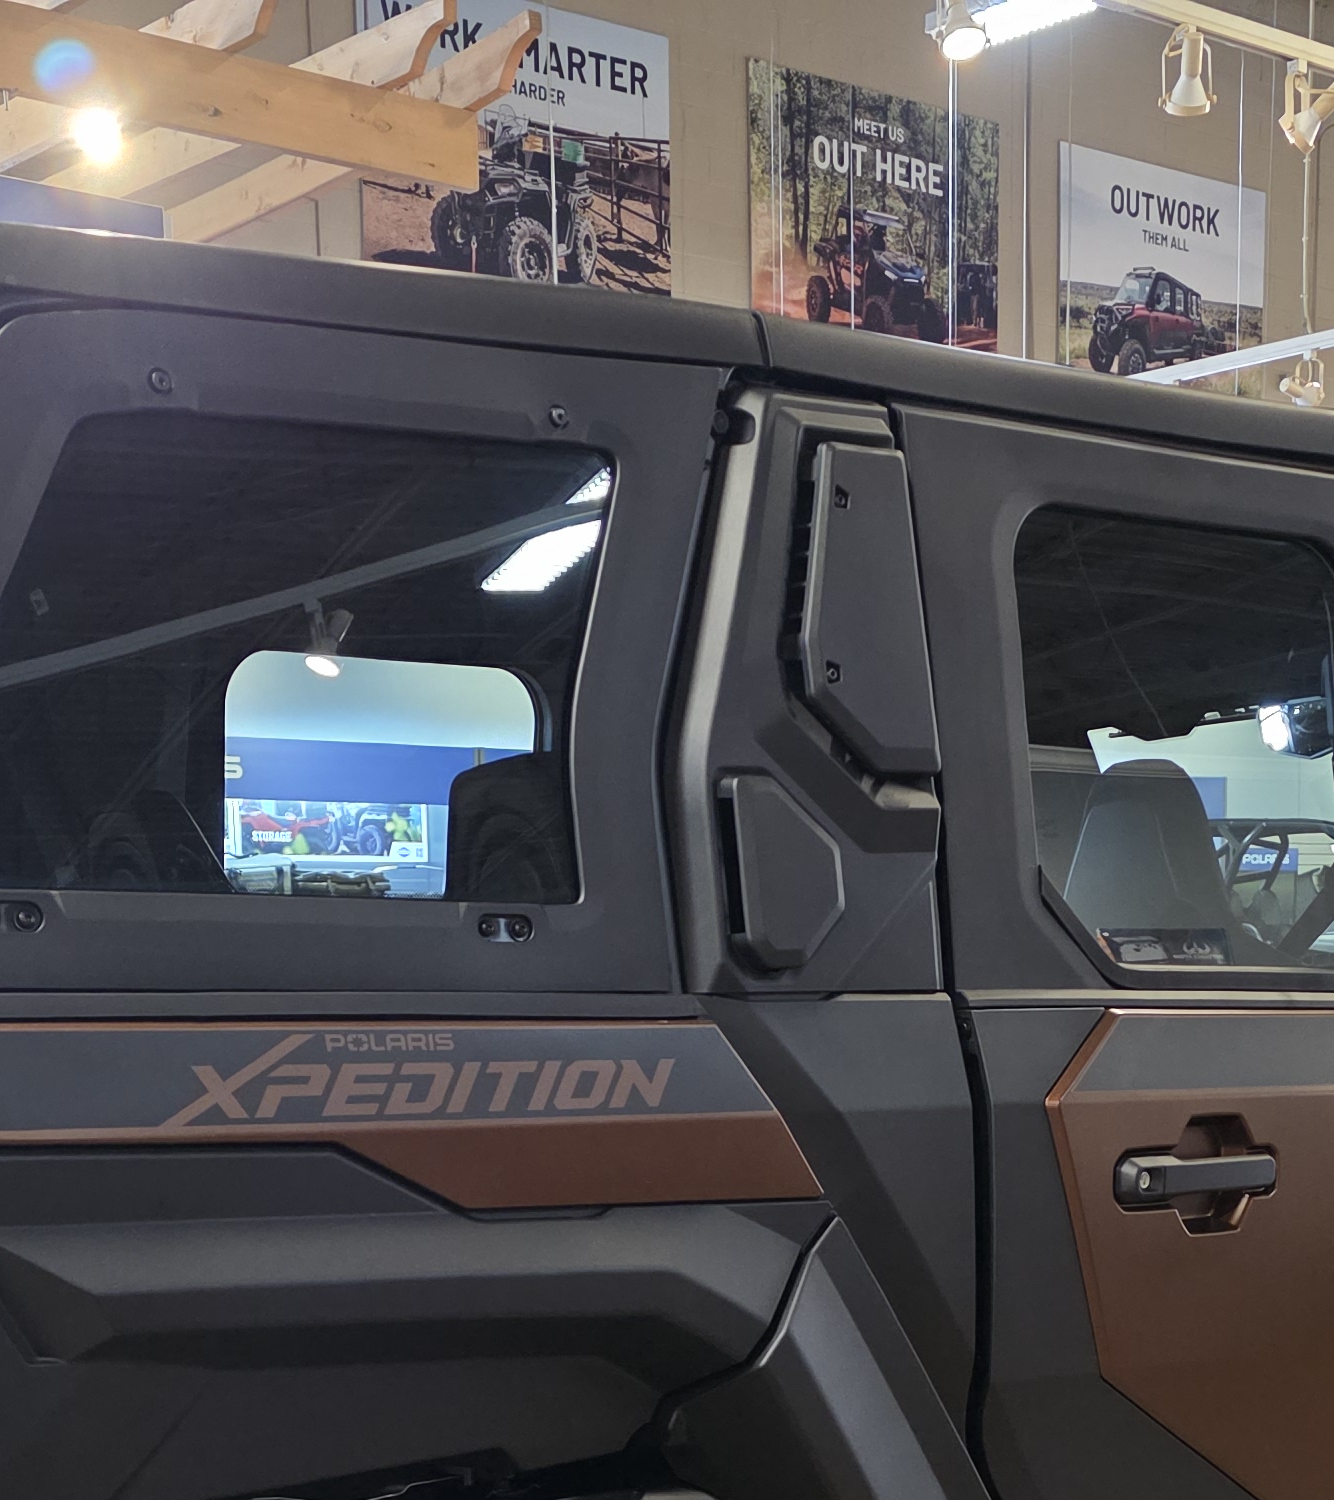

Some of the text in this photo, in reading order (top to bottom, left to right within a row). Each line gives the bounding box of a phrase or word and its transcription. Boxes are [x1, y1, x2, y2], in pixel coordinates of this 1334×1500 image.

[518, 38, 649, 98] MARTER
[854, 116, 905, 143] MEET US
[813, 135, 944, 197] OUT HERE
[1110, 184, 1220, 237] OUTWORK
[1142, 229, 1190, 252] THEM ALL
[251, 830, 293, 843] STORAGE
[1242, 853, 1290, 865] POLARS
[324, 1033, 455, 1052] POLARIS
[162, 1033, 676, 1126] XPEDITION
